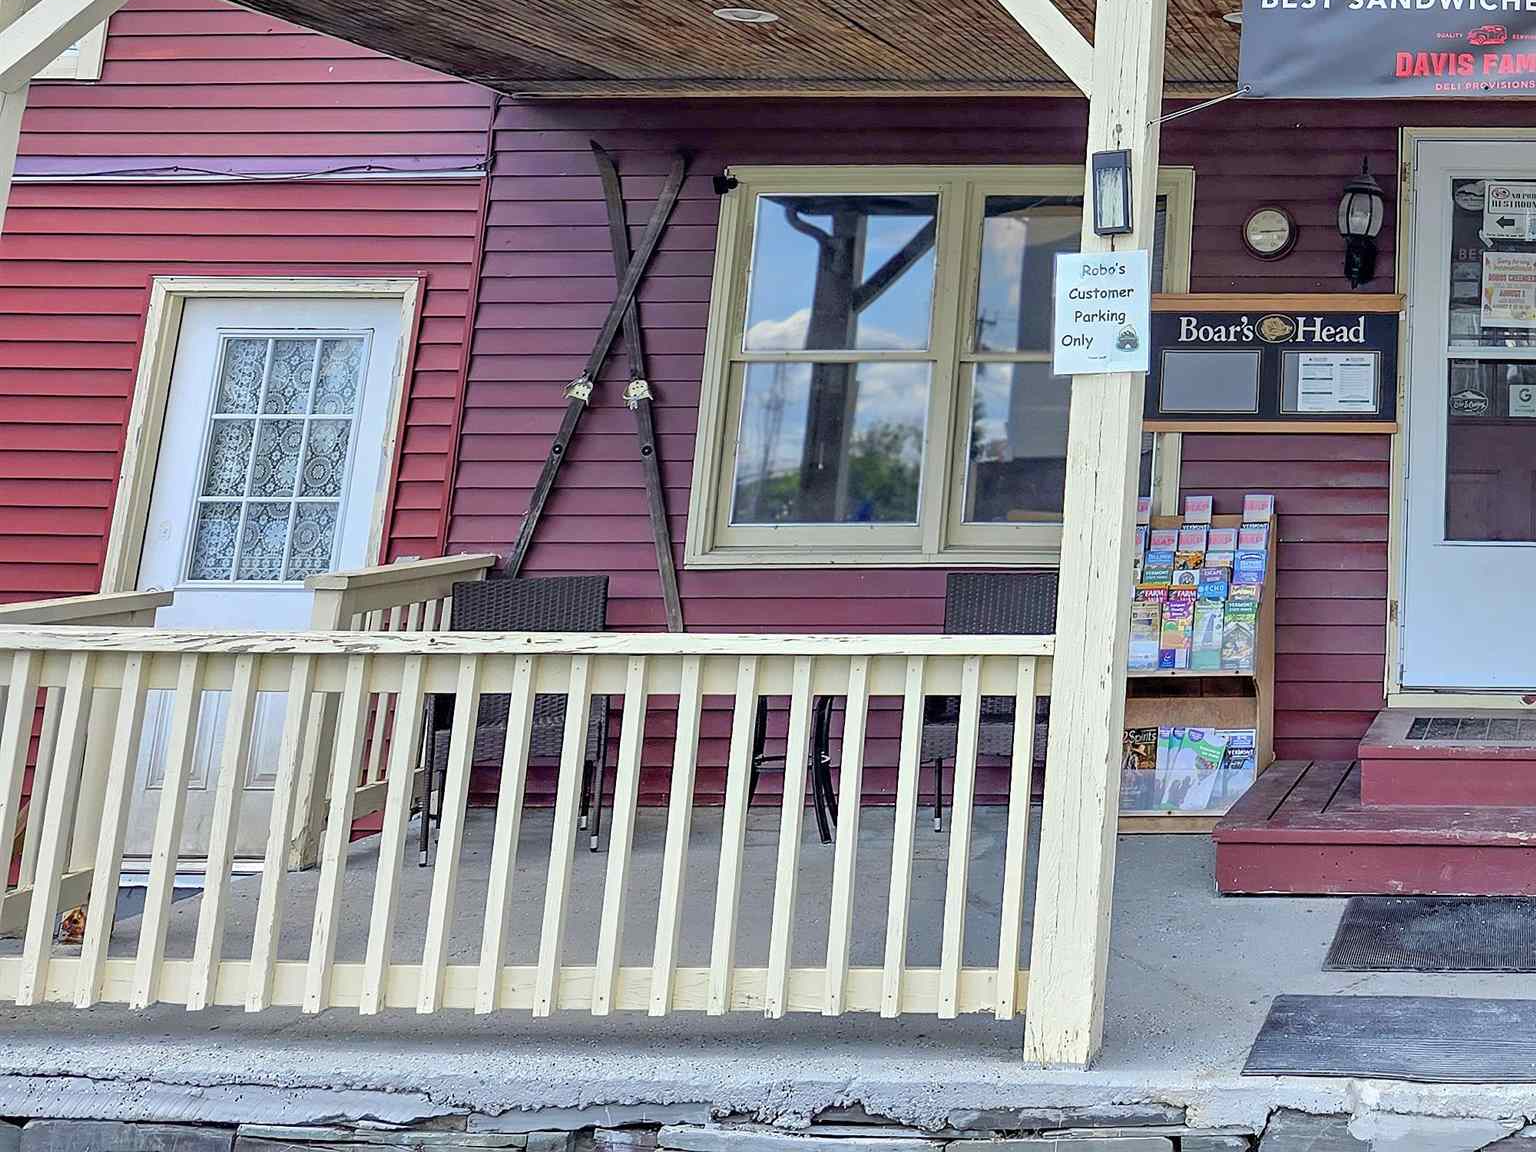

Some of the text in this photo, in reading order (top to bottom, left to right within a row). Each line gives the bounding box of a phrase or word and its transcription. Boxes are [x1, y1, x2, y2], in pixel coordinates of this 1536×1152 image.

[1395, 51, 1475, 79] DAVIS
[1435, 79, 1536, 92] DELI PROVISIONS
[1082, 262, 1126, 277] Robo's
[1068, 288, 1134, 300] Customer
[1074, 309, 1126, 325] Parking
[1177, 315, 1366, 343] Boar's Head
[1061, 333, 1094, 350] Only
